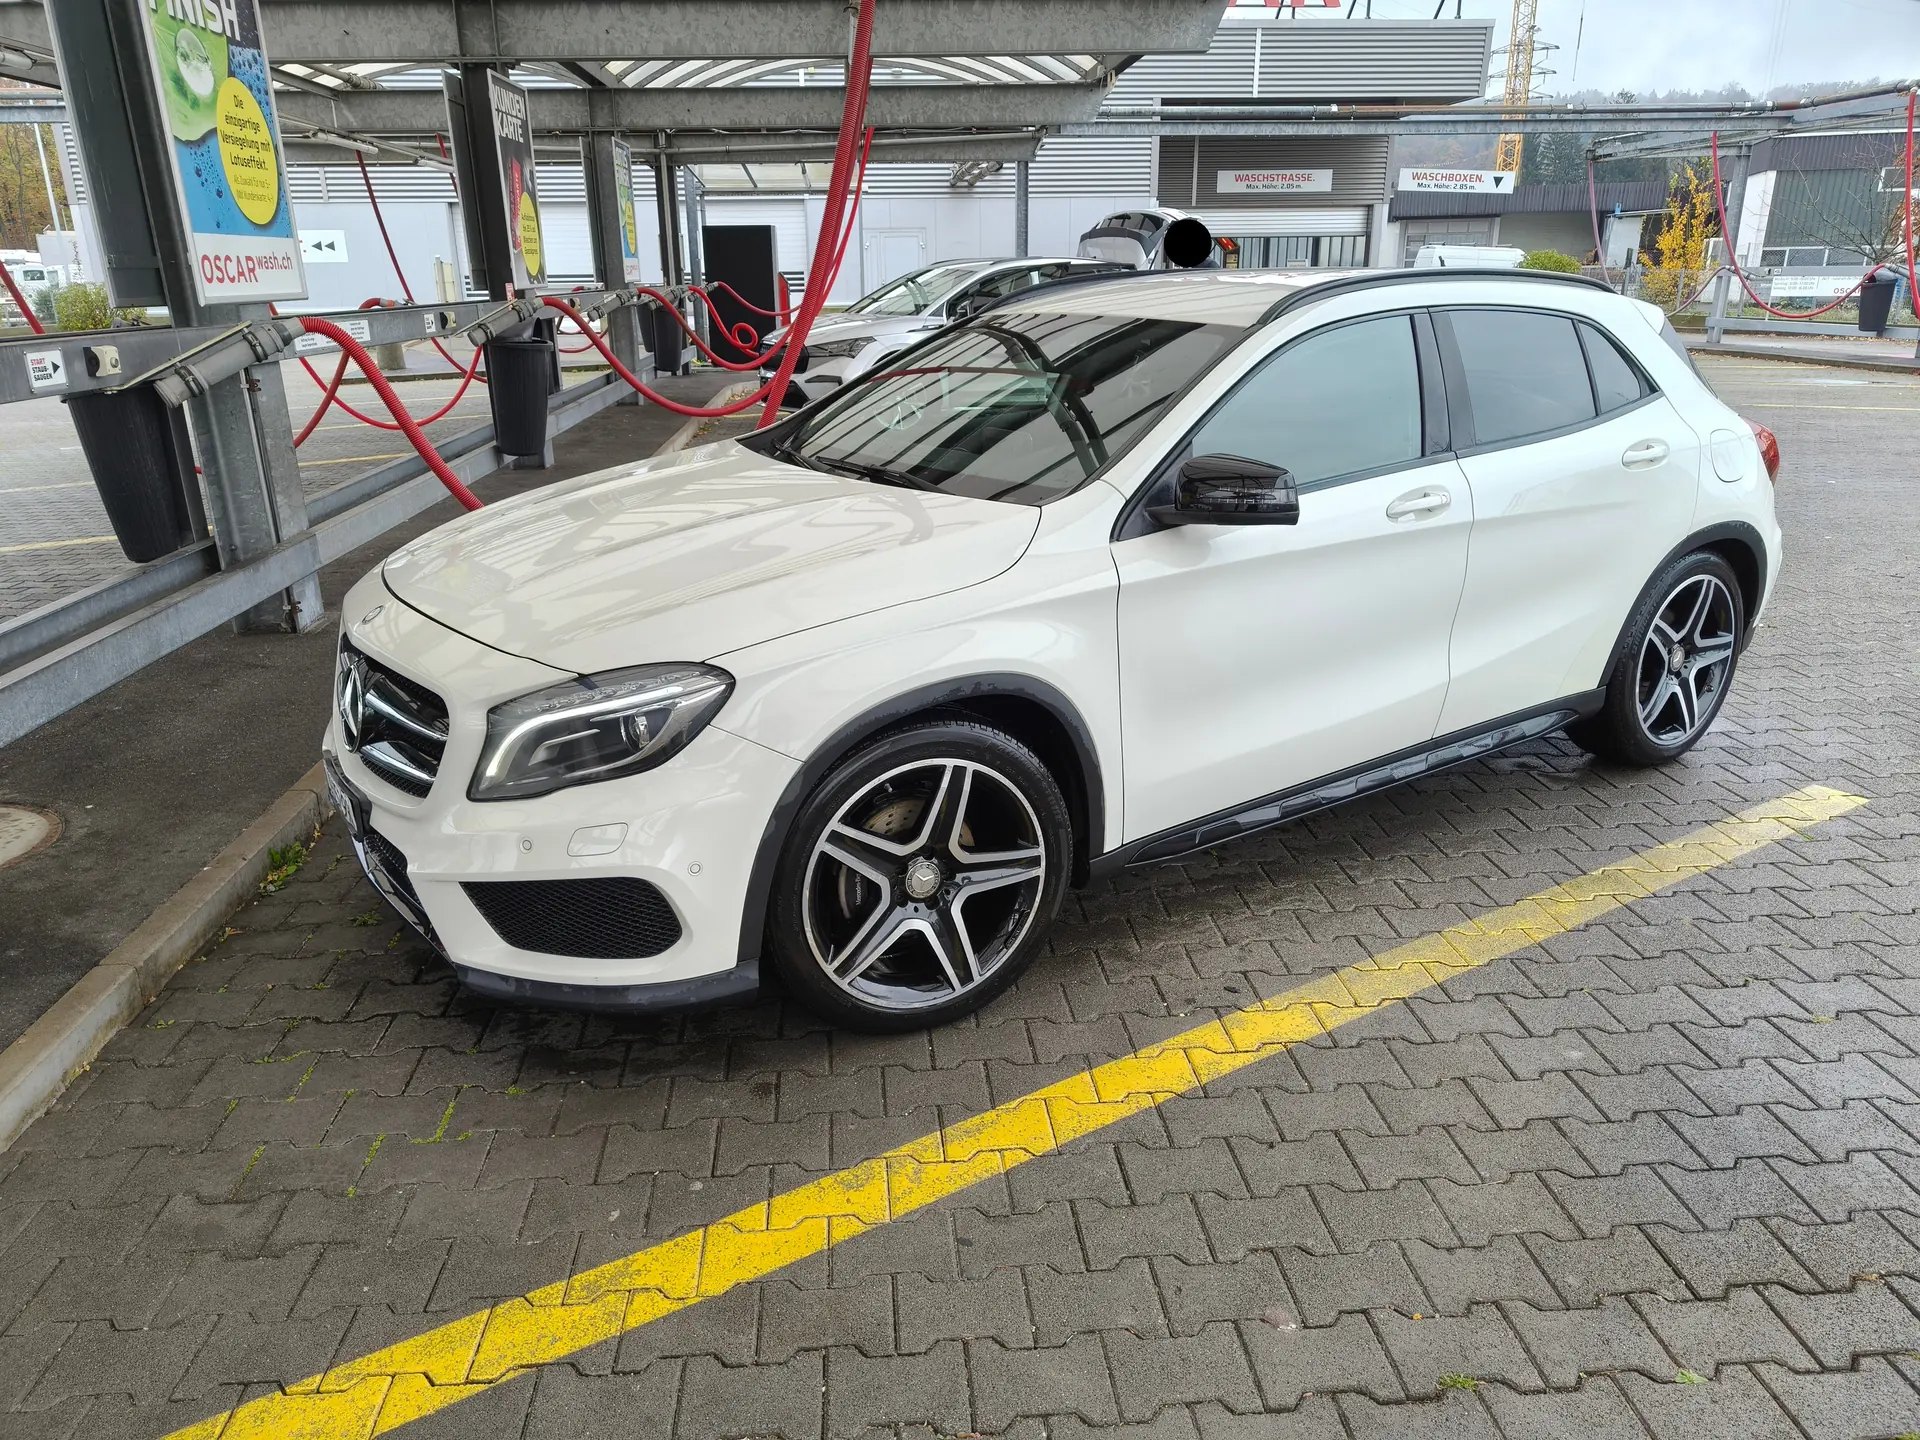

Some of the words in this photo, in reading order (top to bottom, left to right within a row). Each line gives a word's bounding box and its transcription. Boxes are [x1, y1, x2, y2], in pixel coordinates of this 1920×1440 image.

[233, 94, 244, 109] Die
[492, 83, 526, 120] KUNDEN
[225, 111, 261, 134] einzigartige
[495, 111, 524, 143] KARTE
[220, 129, 260, 153] Versiegelung
[260, 139, 271, 152] mit
[229, 152, 268, 170] Lotuseffekt.
[1234, 173, 1315, 182] WASCHSTRASSE.
[1411, 171, 1484, 183] WASCHBOXEN.
[1433, 182, 1452, 190] Höhe:
[31, 358, 46, 366] START
[32, 365, 49, 374] STAUB-
[33, 373, 53, 381] SAUGEN
